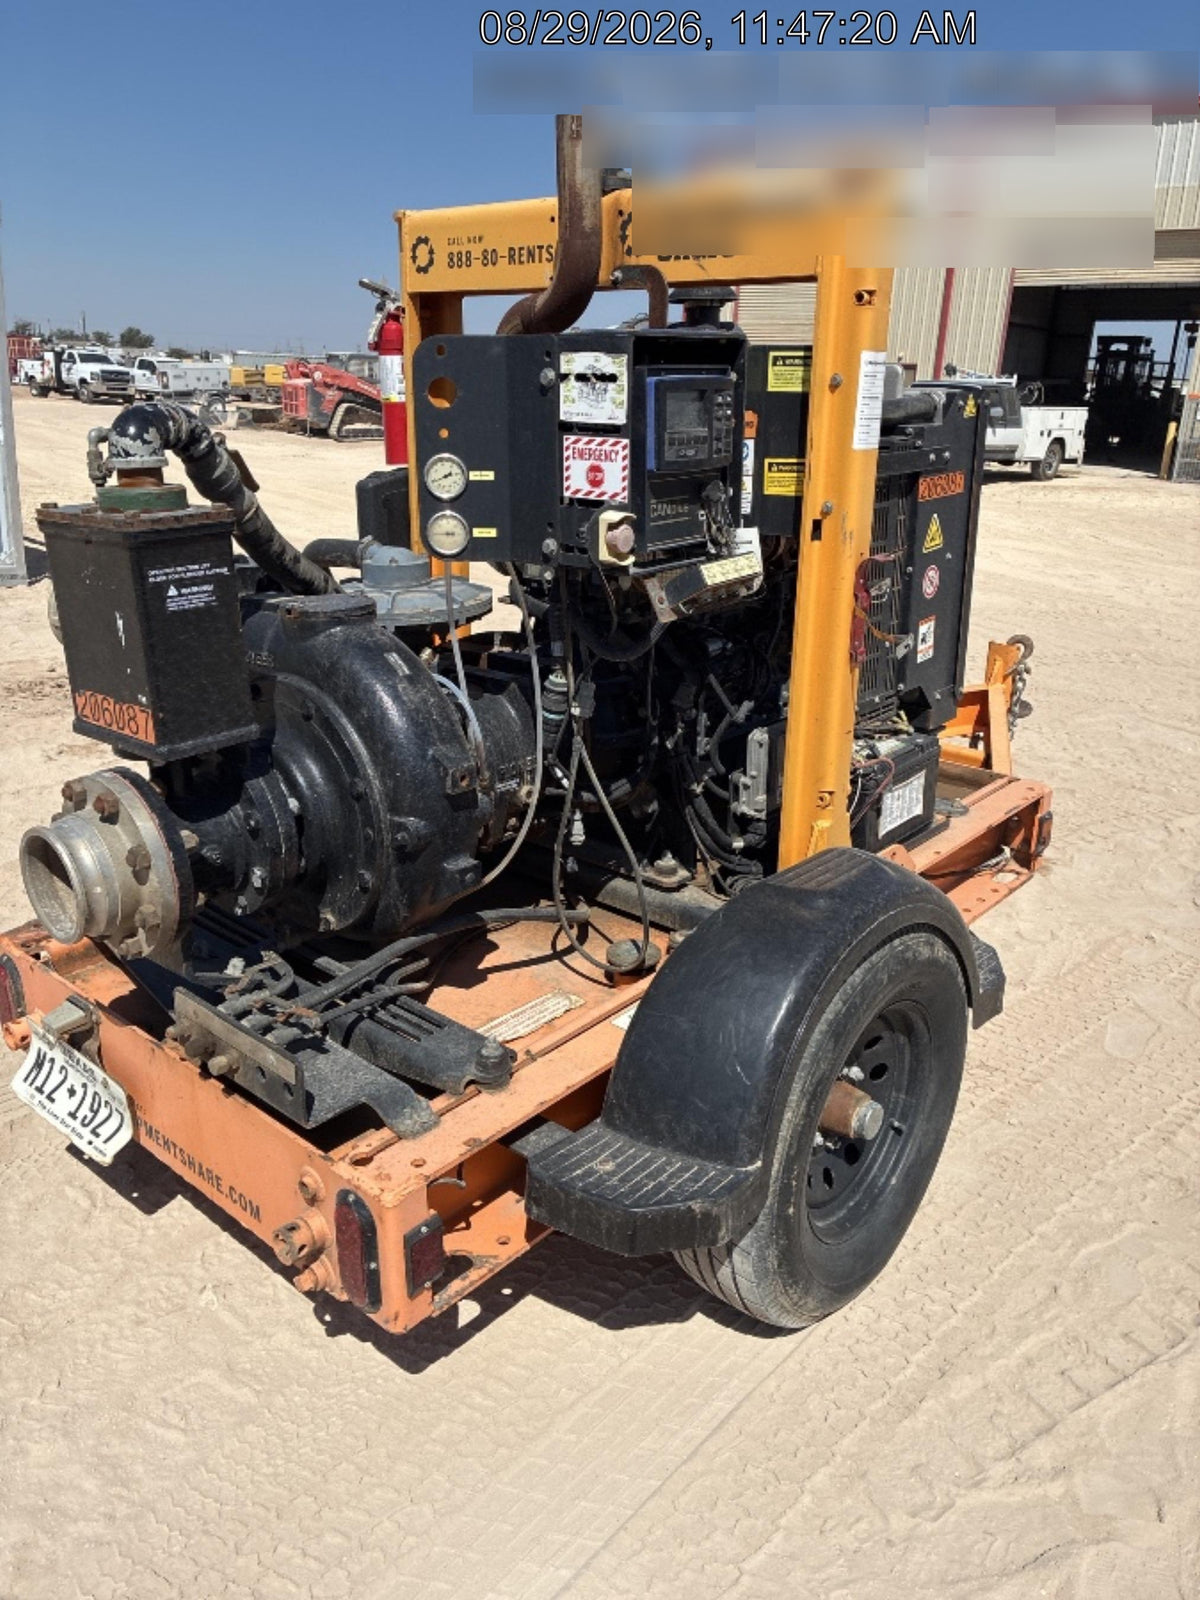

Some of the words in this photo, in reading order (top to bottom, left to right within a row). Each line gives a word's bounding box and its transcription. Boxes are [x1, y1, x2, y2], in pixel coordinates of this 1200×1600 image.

[447, 236, 465, 246] CALL
[467, 235, 484, 244] NOW
[447, 244, 554, 269] 888-80-RENTS
[572, 447, 620, 463] EMERGENCY
[77, 692, 151, 739] 206087
